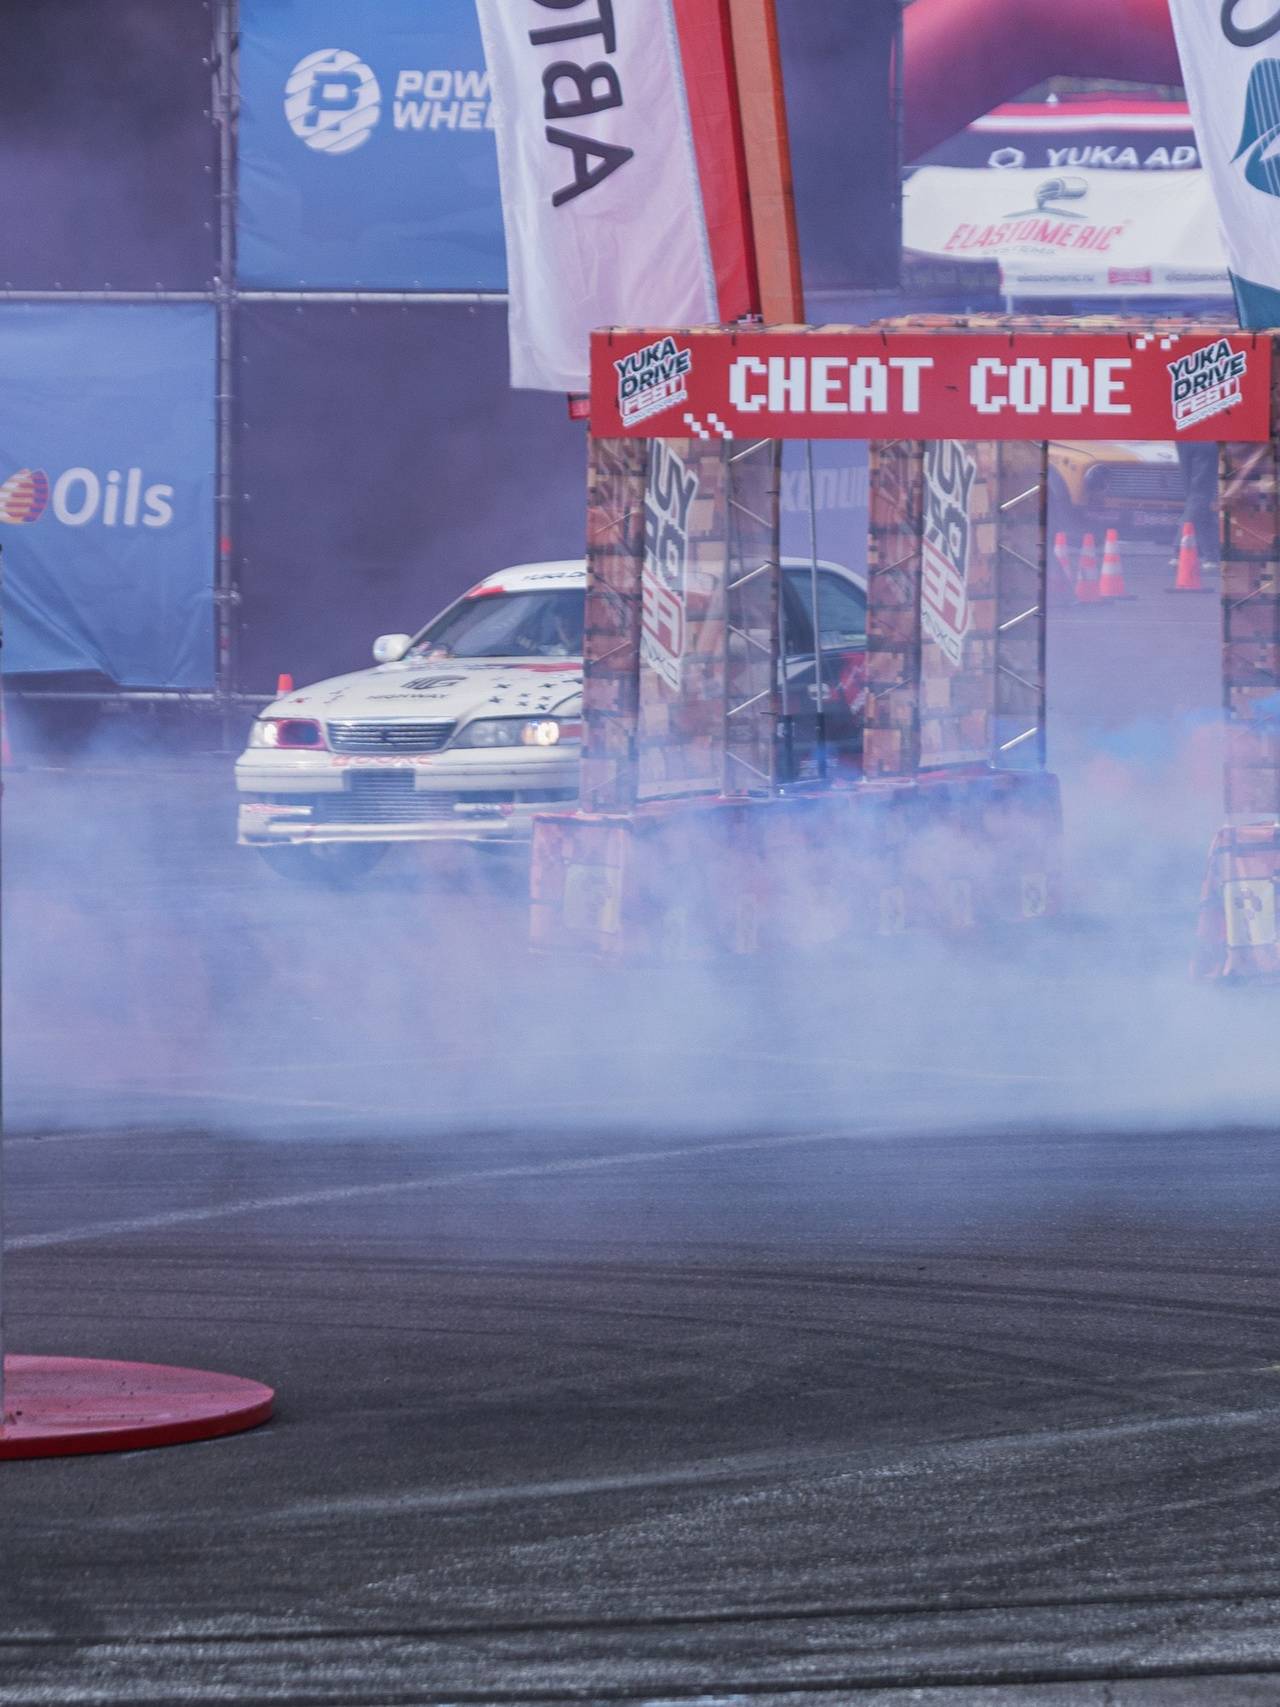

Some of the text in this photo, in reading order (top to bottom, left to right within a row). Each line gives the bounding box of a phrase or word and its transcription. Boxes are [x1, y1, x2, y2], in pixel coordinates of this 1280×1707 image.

[396, 69, 491, 98] POW
[1047, 146, 1197, 166] YUKA AD
[942, 218, 1124, 251] ELASTOMERIC
[615, 338, 678, 377] YUKA
[619, 350, 691, 399] DRIVE
[1168, 339, 1234, 382] YUKA
[1173, 351, 1247, 402] DRIVE
[623, 377, 682, 415] FEST
[729, 356, 935, 413] CHEAT
[969, 357, 1132, 414] CODE
[1176, 377, 1237, 419] FEST
[53, 466, 175, 528] Oils
